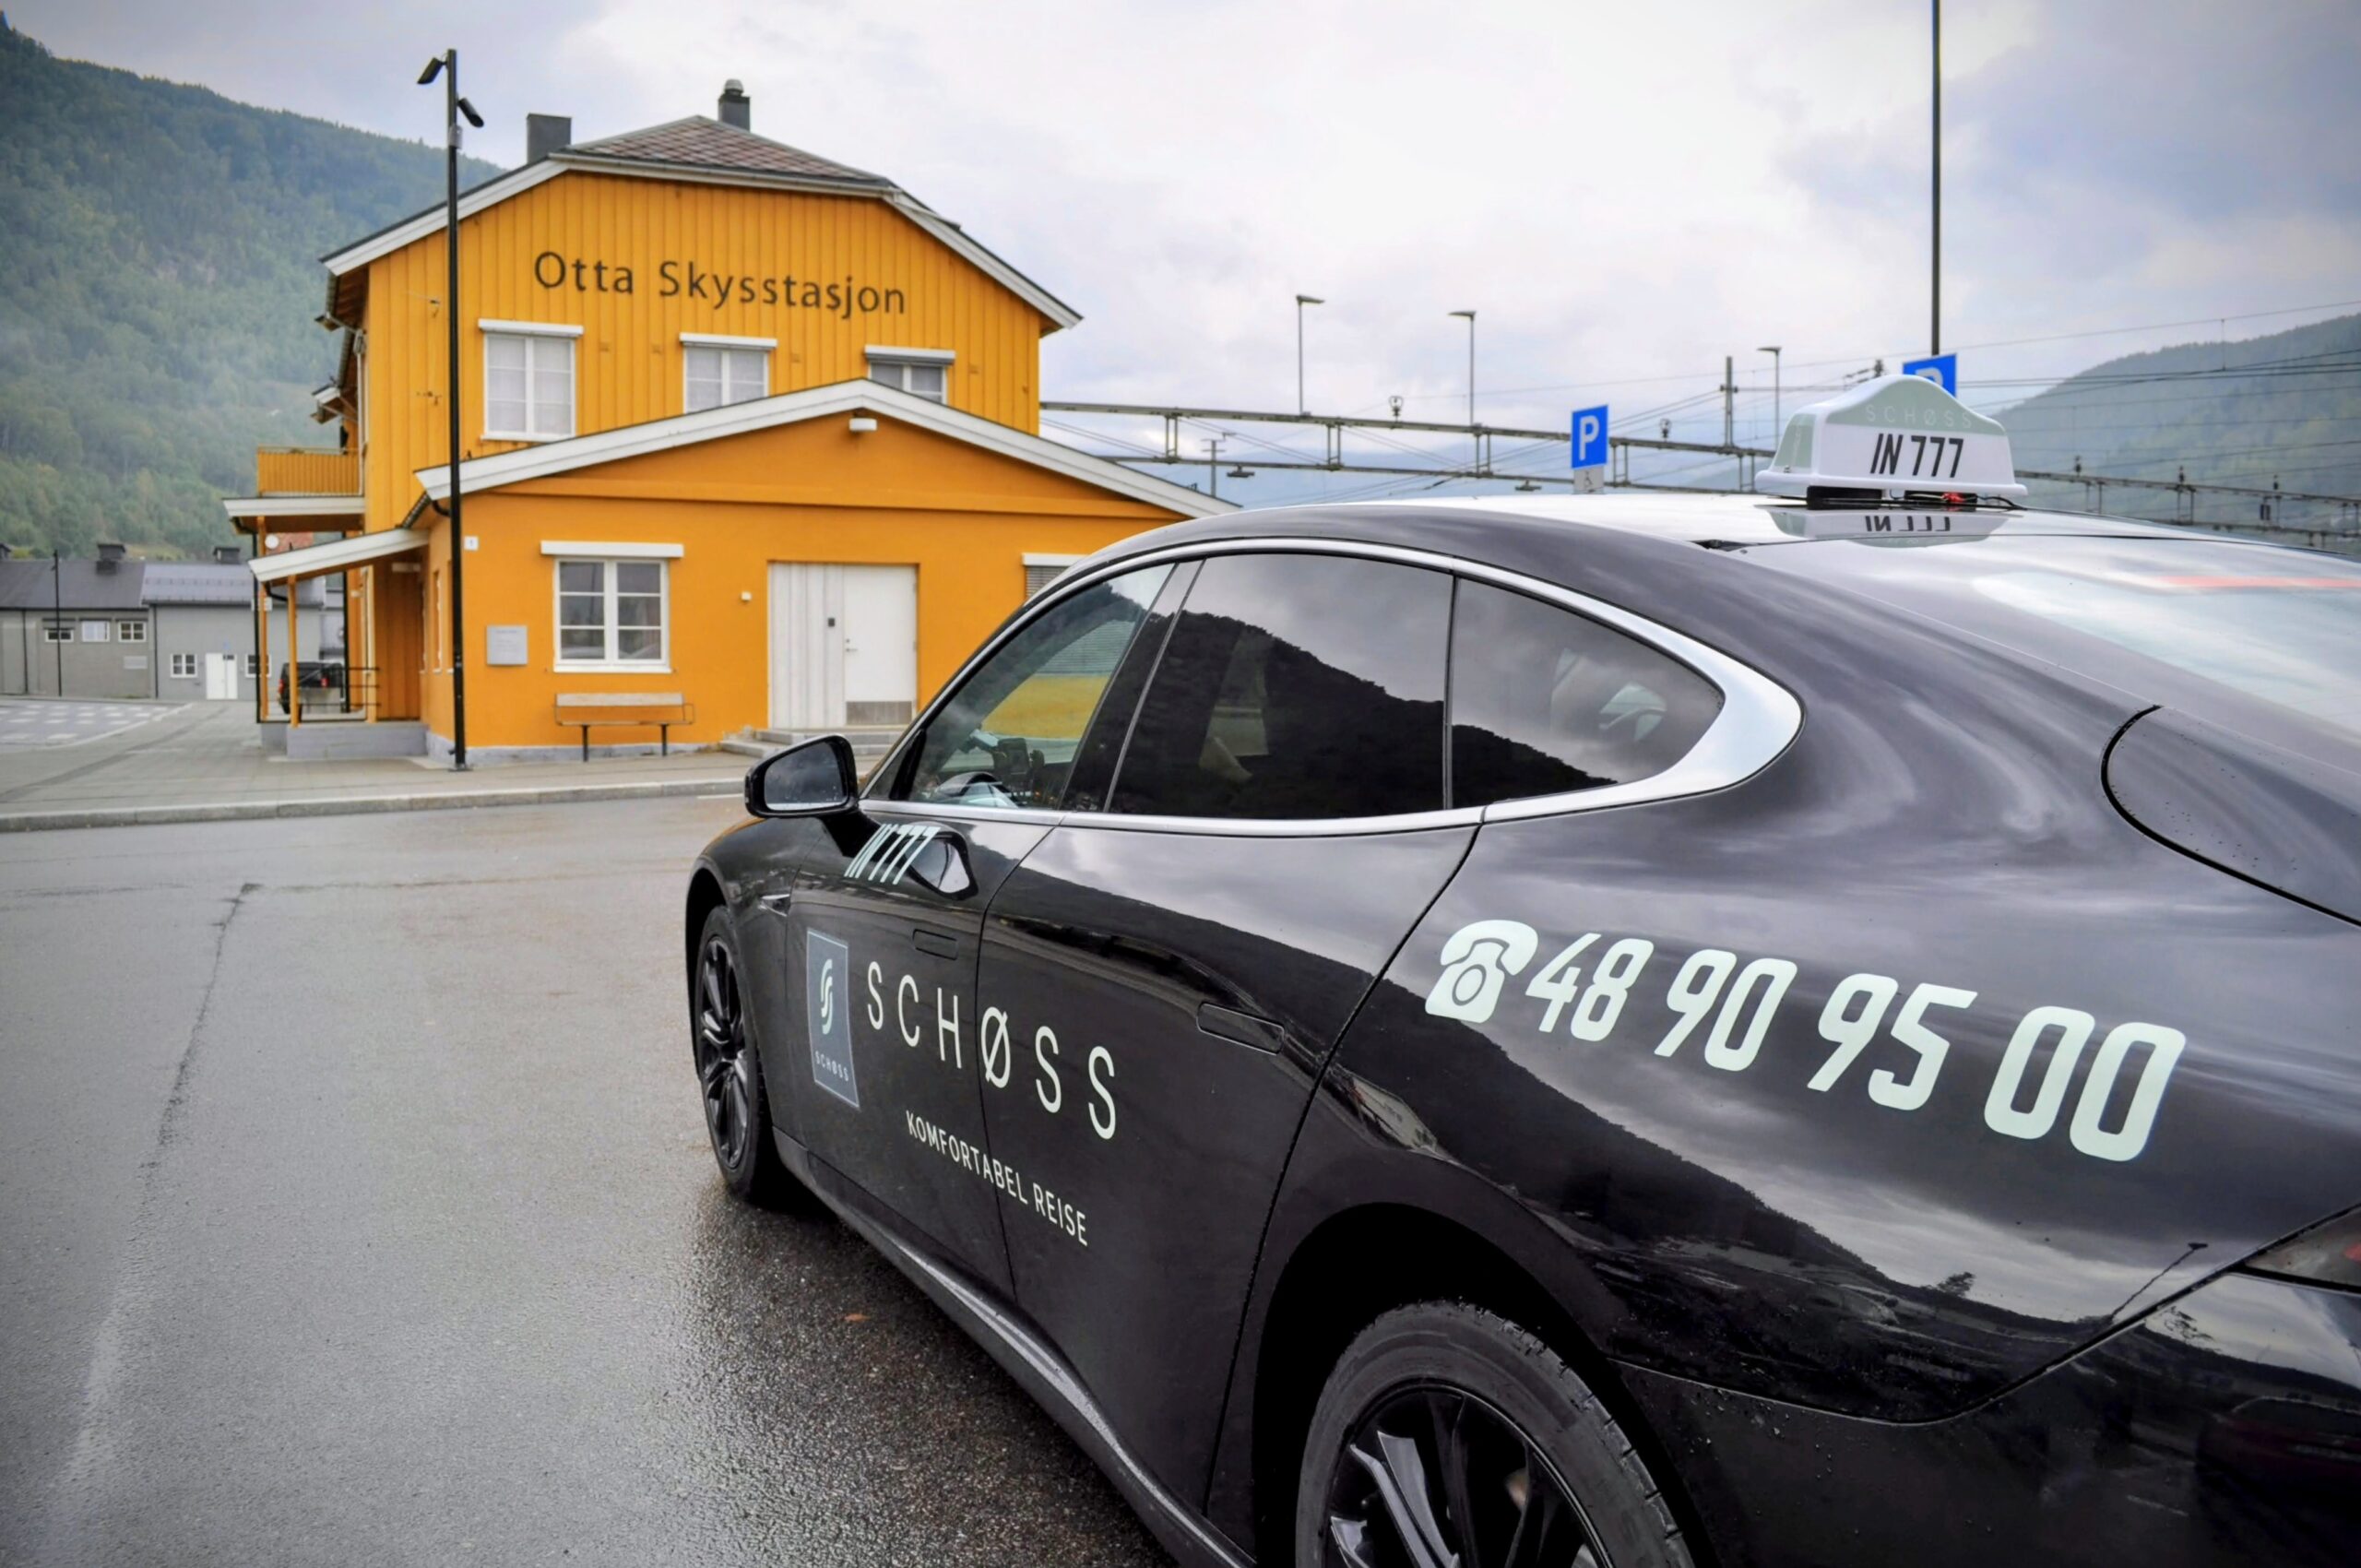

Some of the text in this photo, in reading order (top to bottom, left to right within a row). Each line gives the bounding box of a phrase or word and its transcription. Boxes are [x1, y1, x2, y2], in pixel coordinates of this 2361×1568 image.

[534, 251, 905, 319] Otta Skysstasjon
[1579, 415, 1599, 461] P
[1866, 404, 1972, 429] SCHØSS
[1869, 433, 1964, 479] IN 777
[815, 1051, 849, 1082] SCHØSS
[867, 961, 1117, 1139] SCHØSS
[1525, 932, 2186, 1161] 48 90 95 00
[906, 1110, 1088, 1246] KOMFORTABEL REISE
